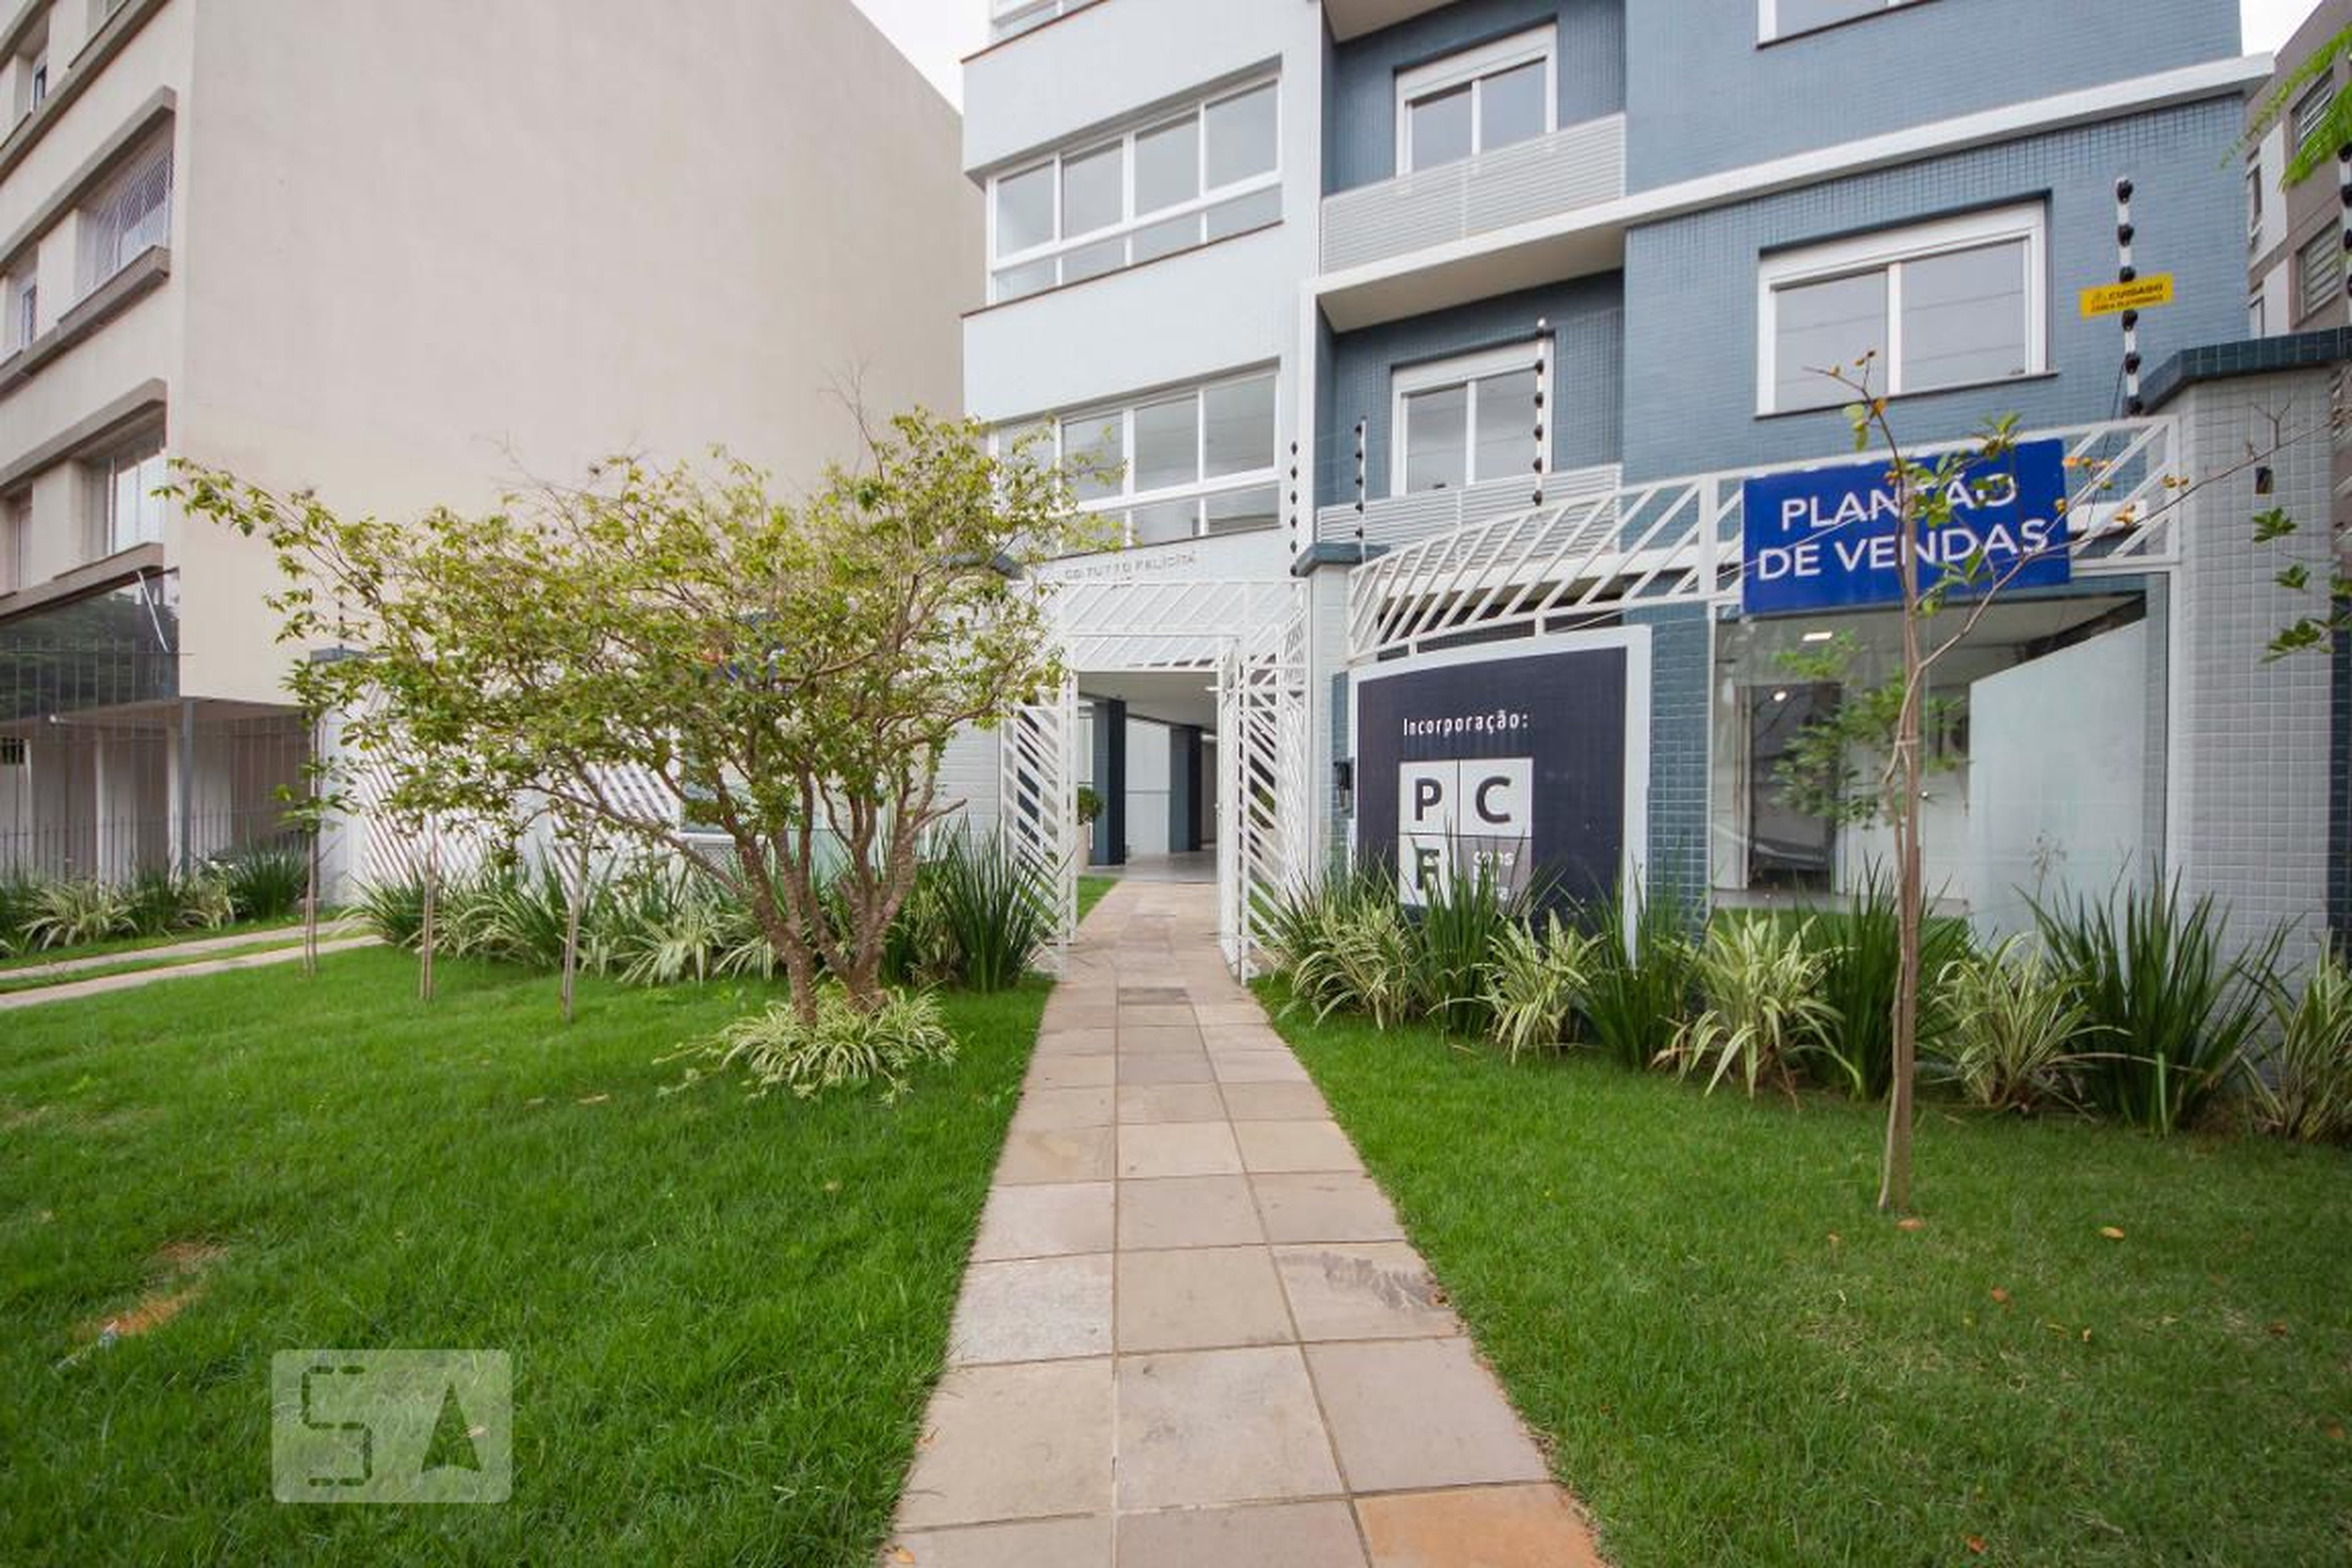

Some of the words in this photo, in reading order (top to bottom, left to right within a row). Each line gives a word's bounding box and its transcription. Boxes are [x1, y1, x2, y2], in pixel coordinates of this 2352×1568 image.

[1782, 472, 2017, 531] PLANÃO
[1758, 544, 1822, 581] DE
[1834, 518, 2048, 572] VENDAS
[1403, 709, 1529, 736] Incorporação:
